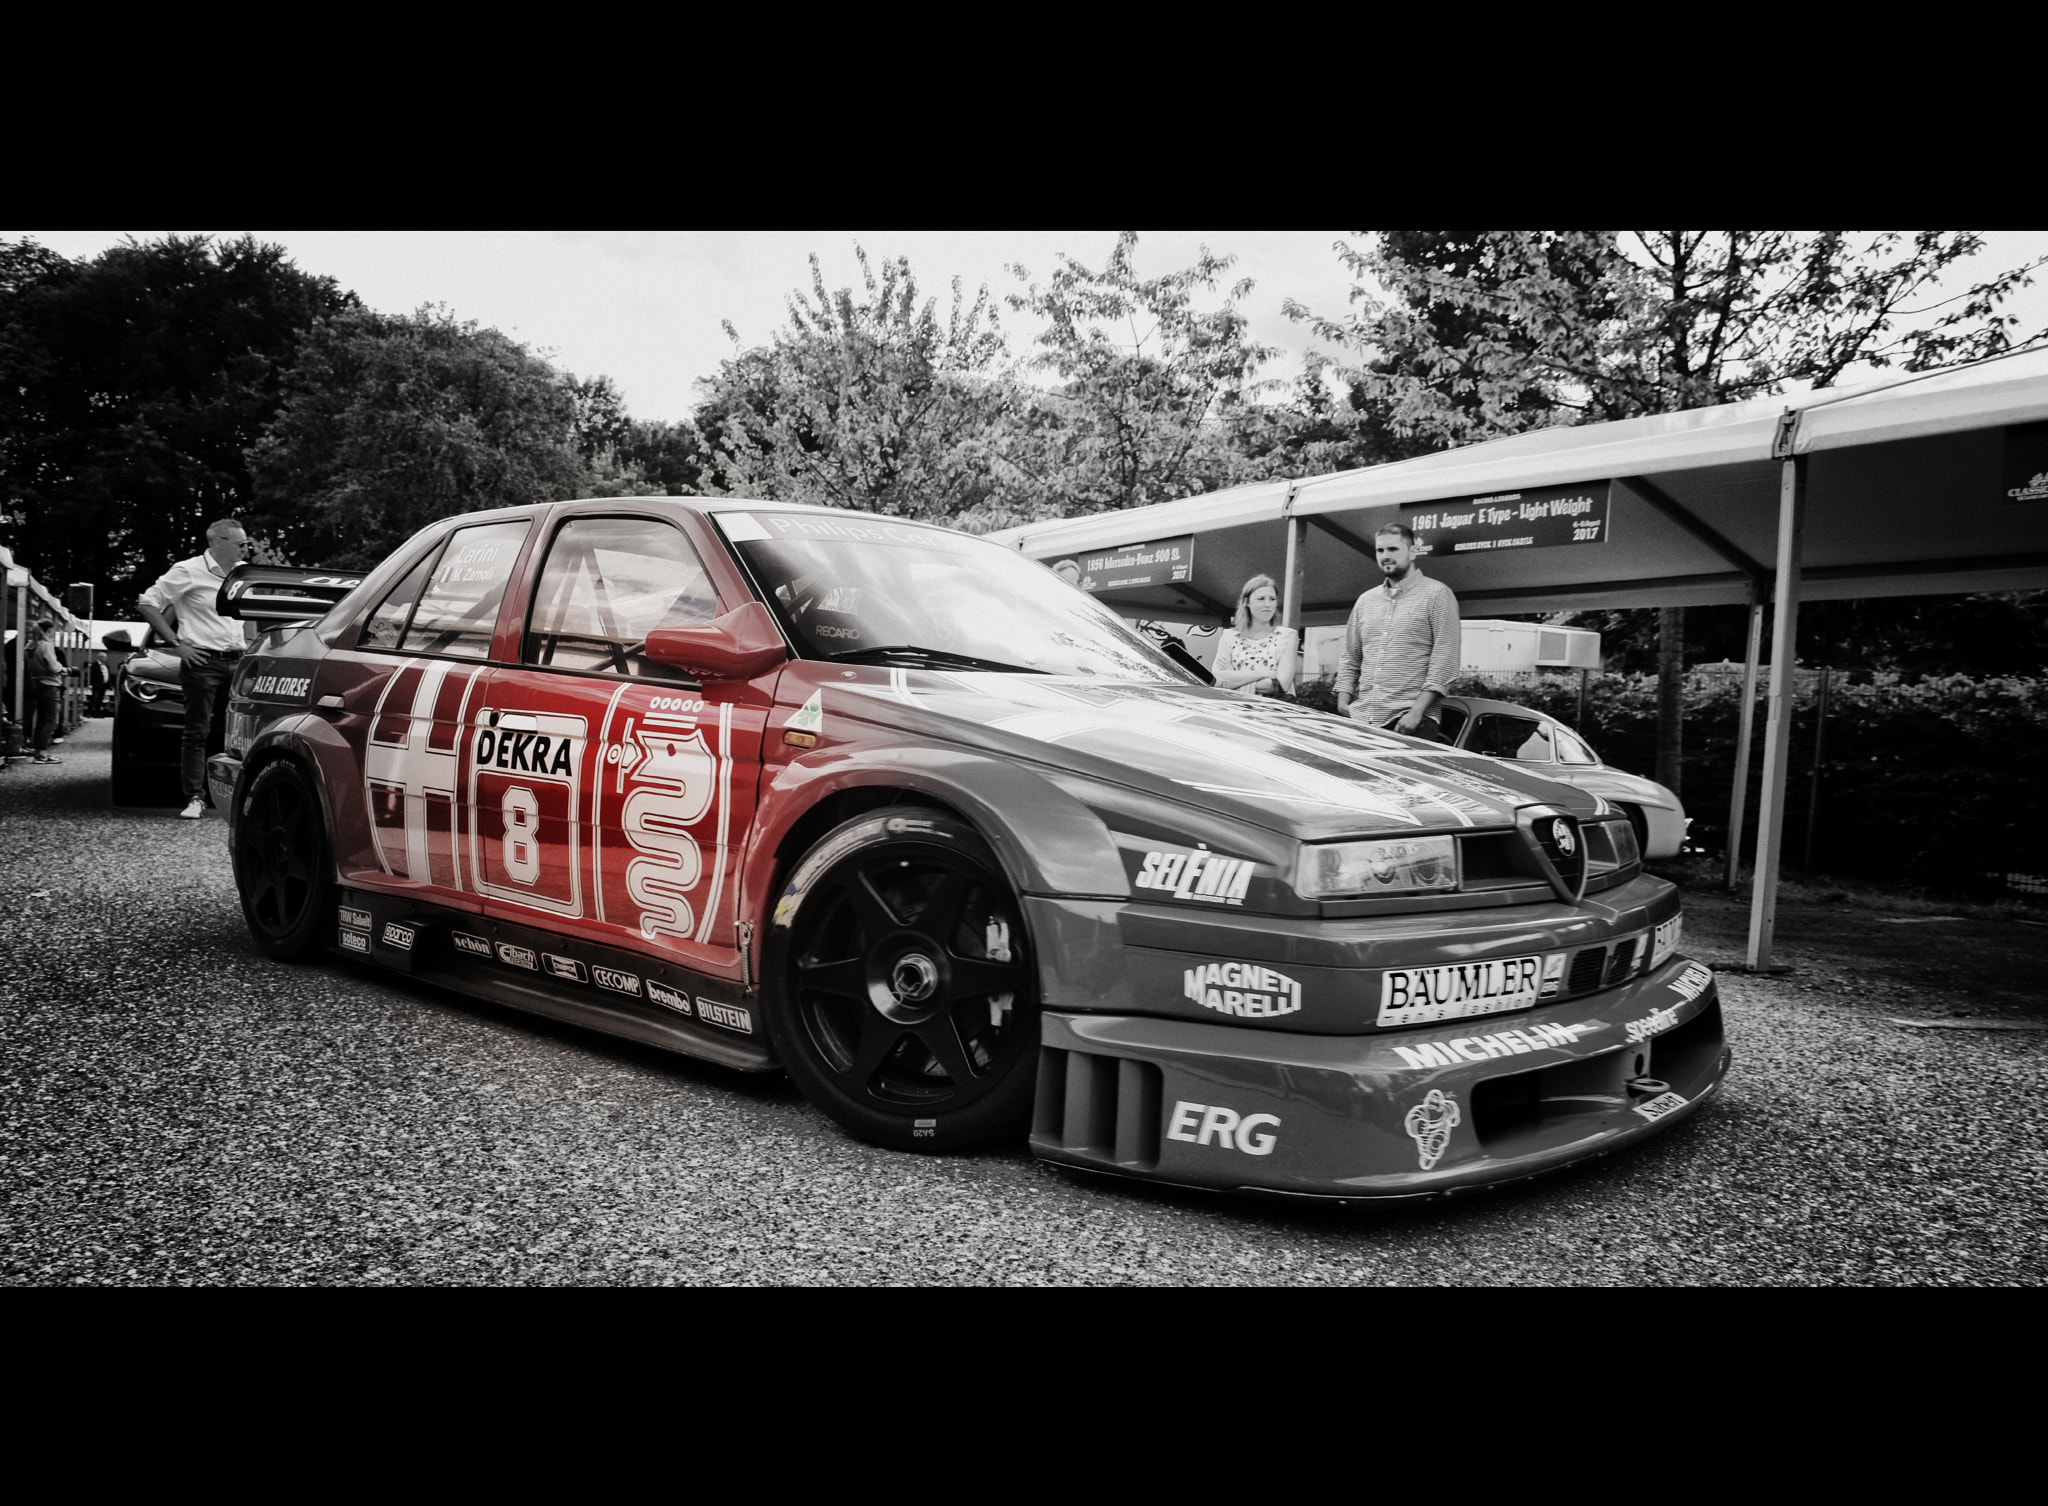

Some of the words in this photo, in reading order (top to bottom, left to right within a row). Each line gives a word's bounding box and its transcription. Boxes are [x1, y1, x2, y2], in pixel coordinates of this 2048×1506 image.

[1412, 514, 1437, 531] 1961
[1440, 513, 1475, 529] Jaguar
[1519, 502, 1549, 521] Light
[1550, 496, 1593, 517] Weight
[768, 517, 884, 541] Philips
[1573, 527, 1599, 541] 2017
[456, 543, 501, 563] Larini
[227, 580, 245, 600] 8
[816, 625, 860, 640] RECARO
[253, 675, 277, 694] ALFA
[275, 677, 311, 697] CORSE
[477, 730, 572, 777] DEKRA
[502, 785, 540, 886] 8
[339, 910, 352, 923] TRW
[353, 912, 371, 927] Sabelt
[386, 924, 412, 943] sparco
[454, 936, 490, 954] schön
[596, 969, 639, 994] CECOMP
[1184, 962, 1302, 995] MAGNETI
[650, 984, 690, 1012] brembo
[1184, 985, 1302, 1018] MARELLI
[700, 1002, 750, 1030] BILSTEIN
[1391, 1022, 1580, 1070] MICHELIN
[1166, 1100, 1282, 1156] ERG
